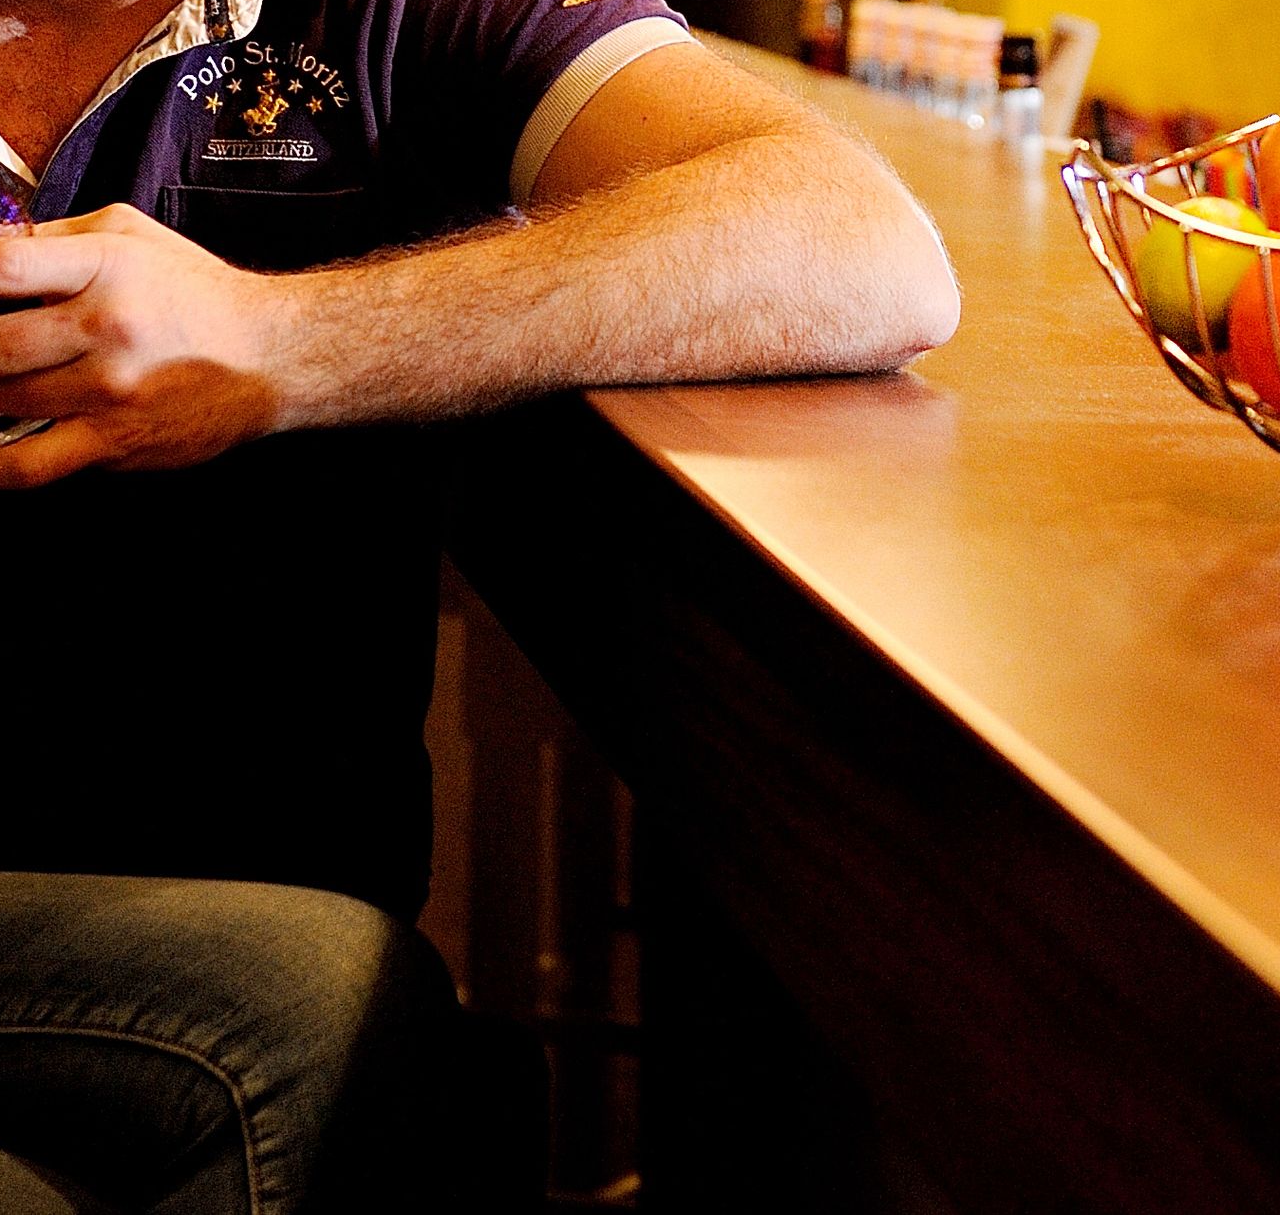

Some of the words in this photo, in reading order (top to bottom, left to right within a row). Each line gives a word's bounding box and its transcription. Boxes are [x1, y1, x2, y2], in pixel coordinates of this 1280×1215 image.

[177, 55, 236, 101] Polo
[243, 41, 279, 65] St.
[282, 41, 351, 109] Moritz
[206, 143, 314, 158] SWITZERLAND
